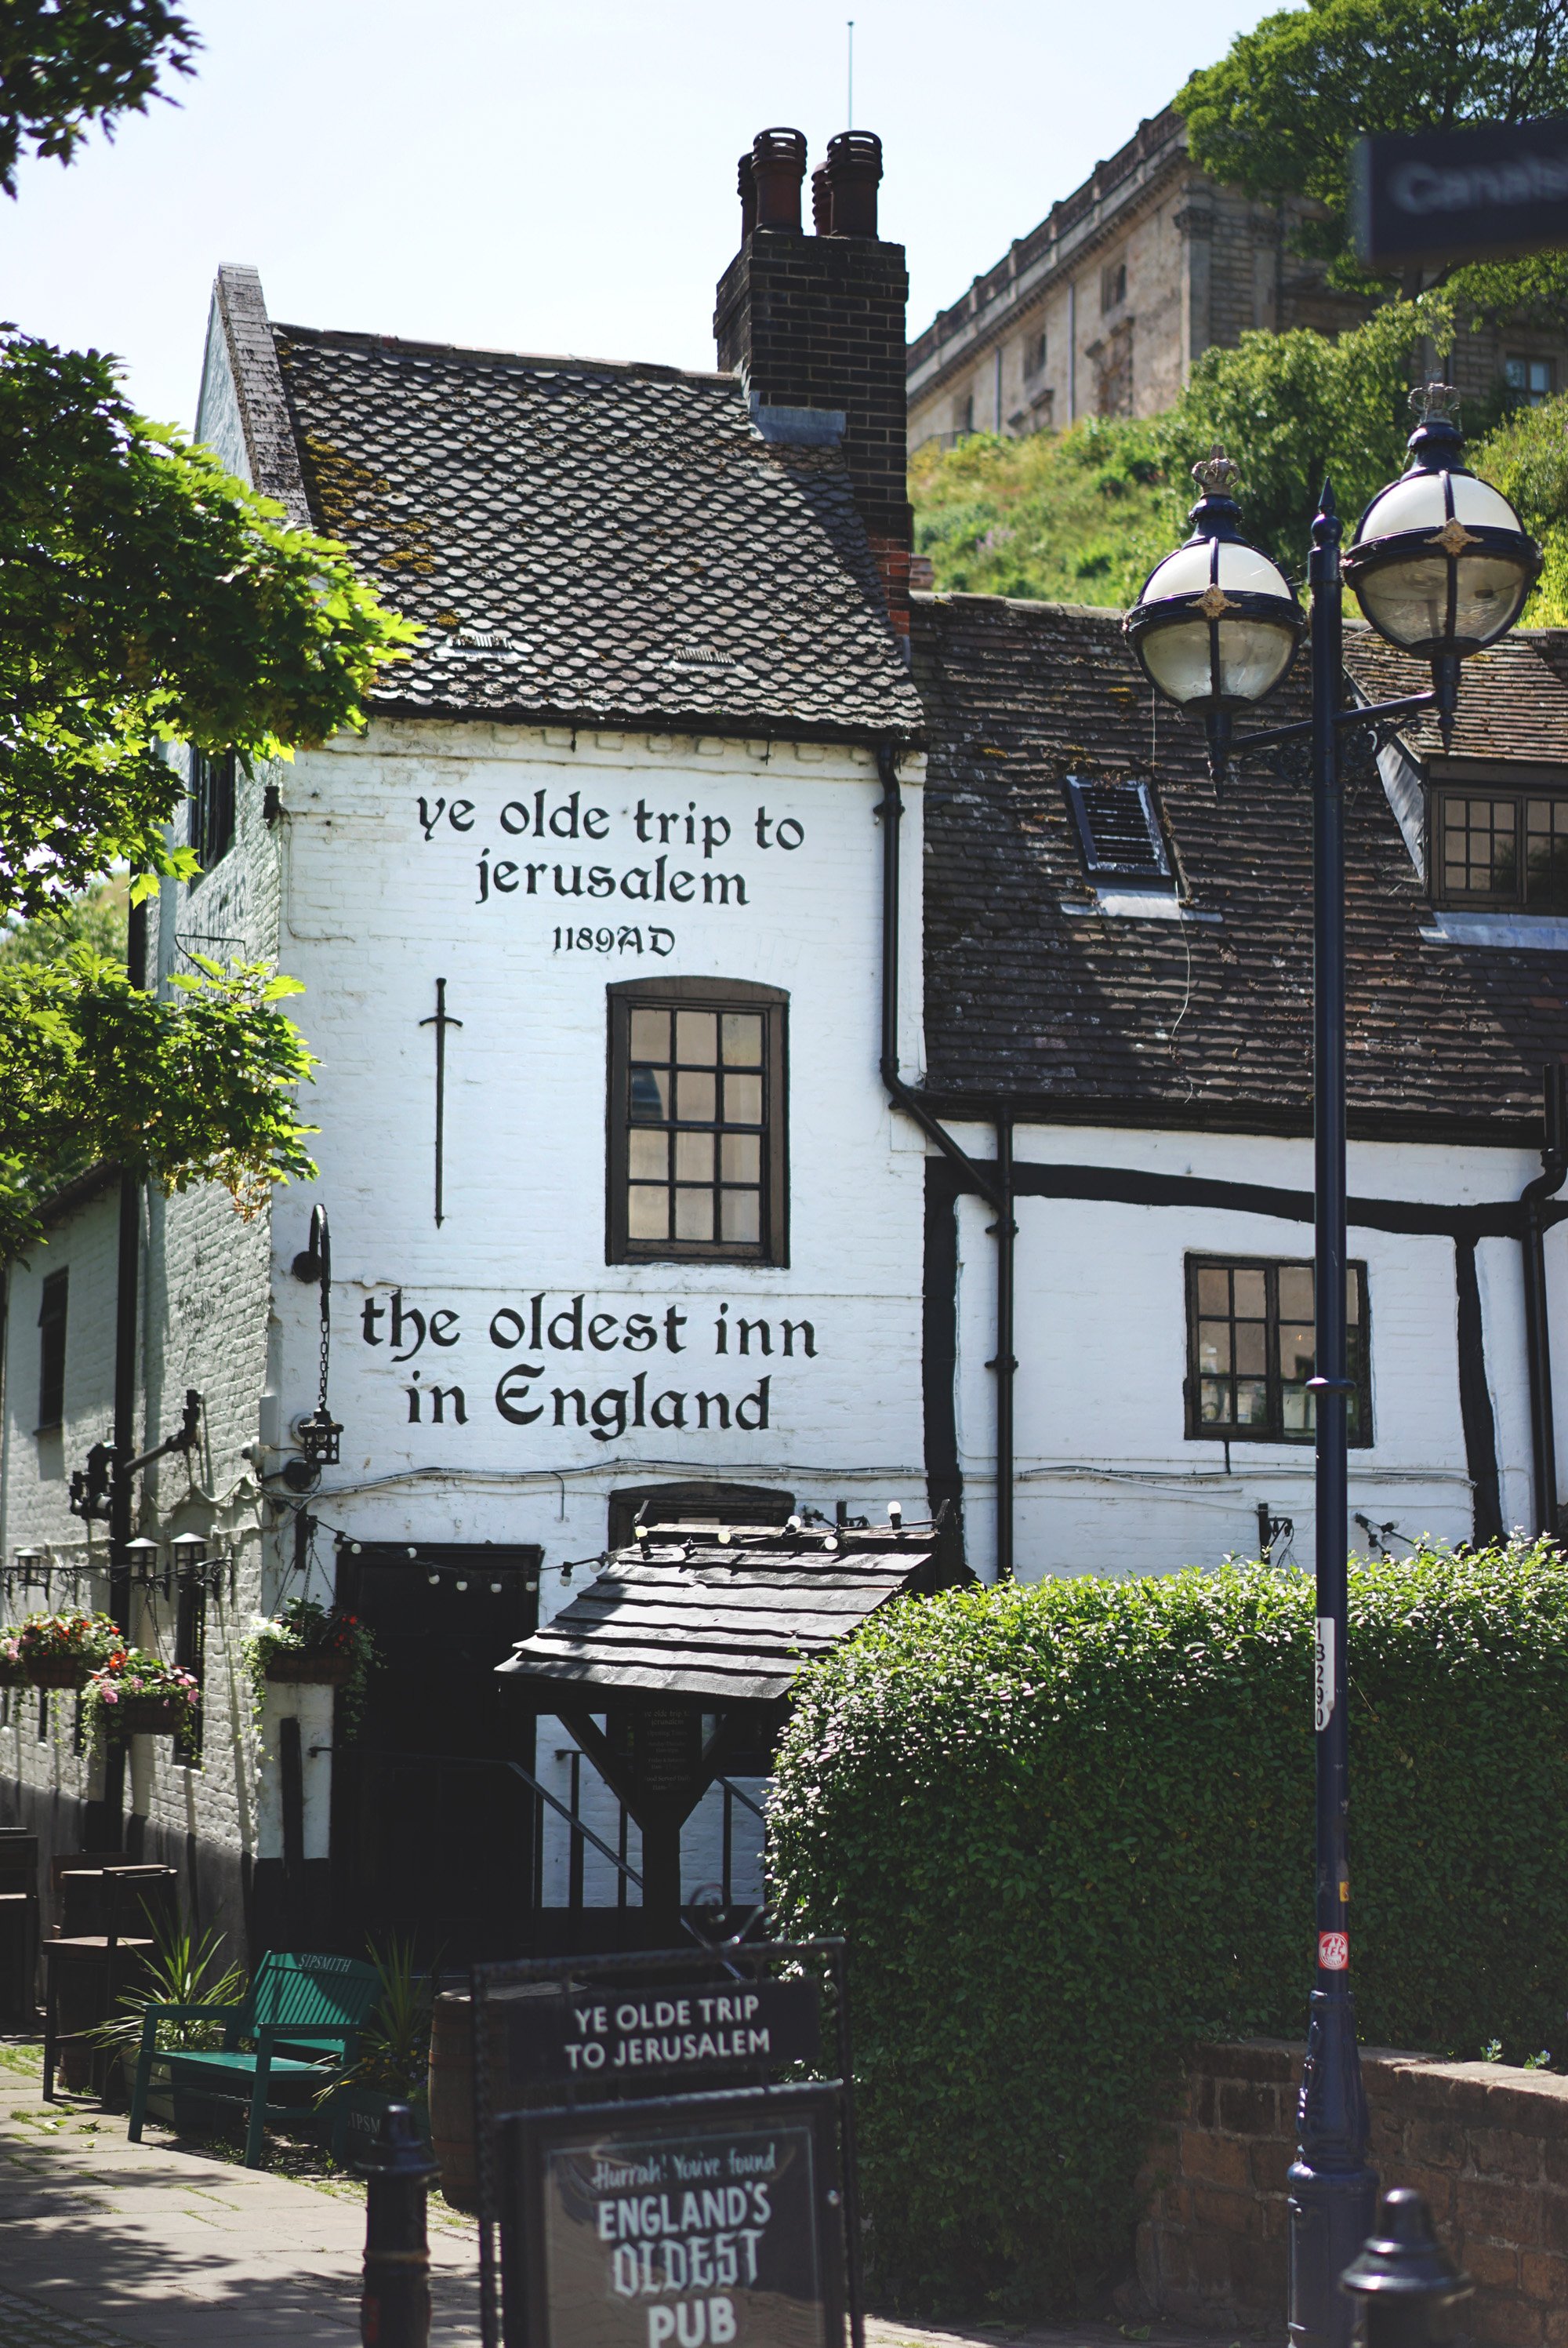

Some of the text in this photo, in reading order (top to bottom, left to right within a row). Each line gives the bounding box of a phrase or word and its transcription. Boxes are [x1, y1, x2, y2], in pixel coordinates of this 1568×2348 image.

[416, 788, 805, 859] ye olde trip to
[474, 848, 750, 906] jerusalem
[360, 1287, 818, 1362] the oldest inn
[405, 1363, 771, 1442] in England
[298, 1954, 353, 1973] SIPSMITH
[575, 1994, 760, 2034] YE OLDE TRIP
[564, 2028, 771, 2070] TO JERUSALEM
[728, 2141, 777, 2175] found
[597, 2180, 772, 2241] ENGLAND'S
[612, 2227, 766, 2299] OLDEST
[648, 2295, 737, 2348] PUB
